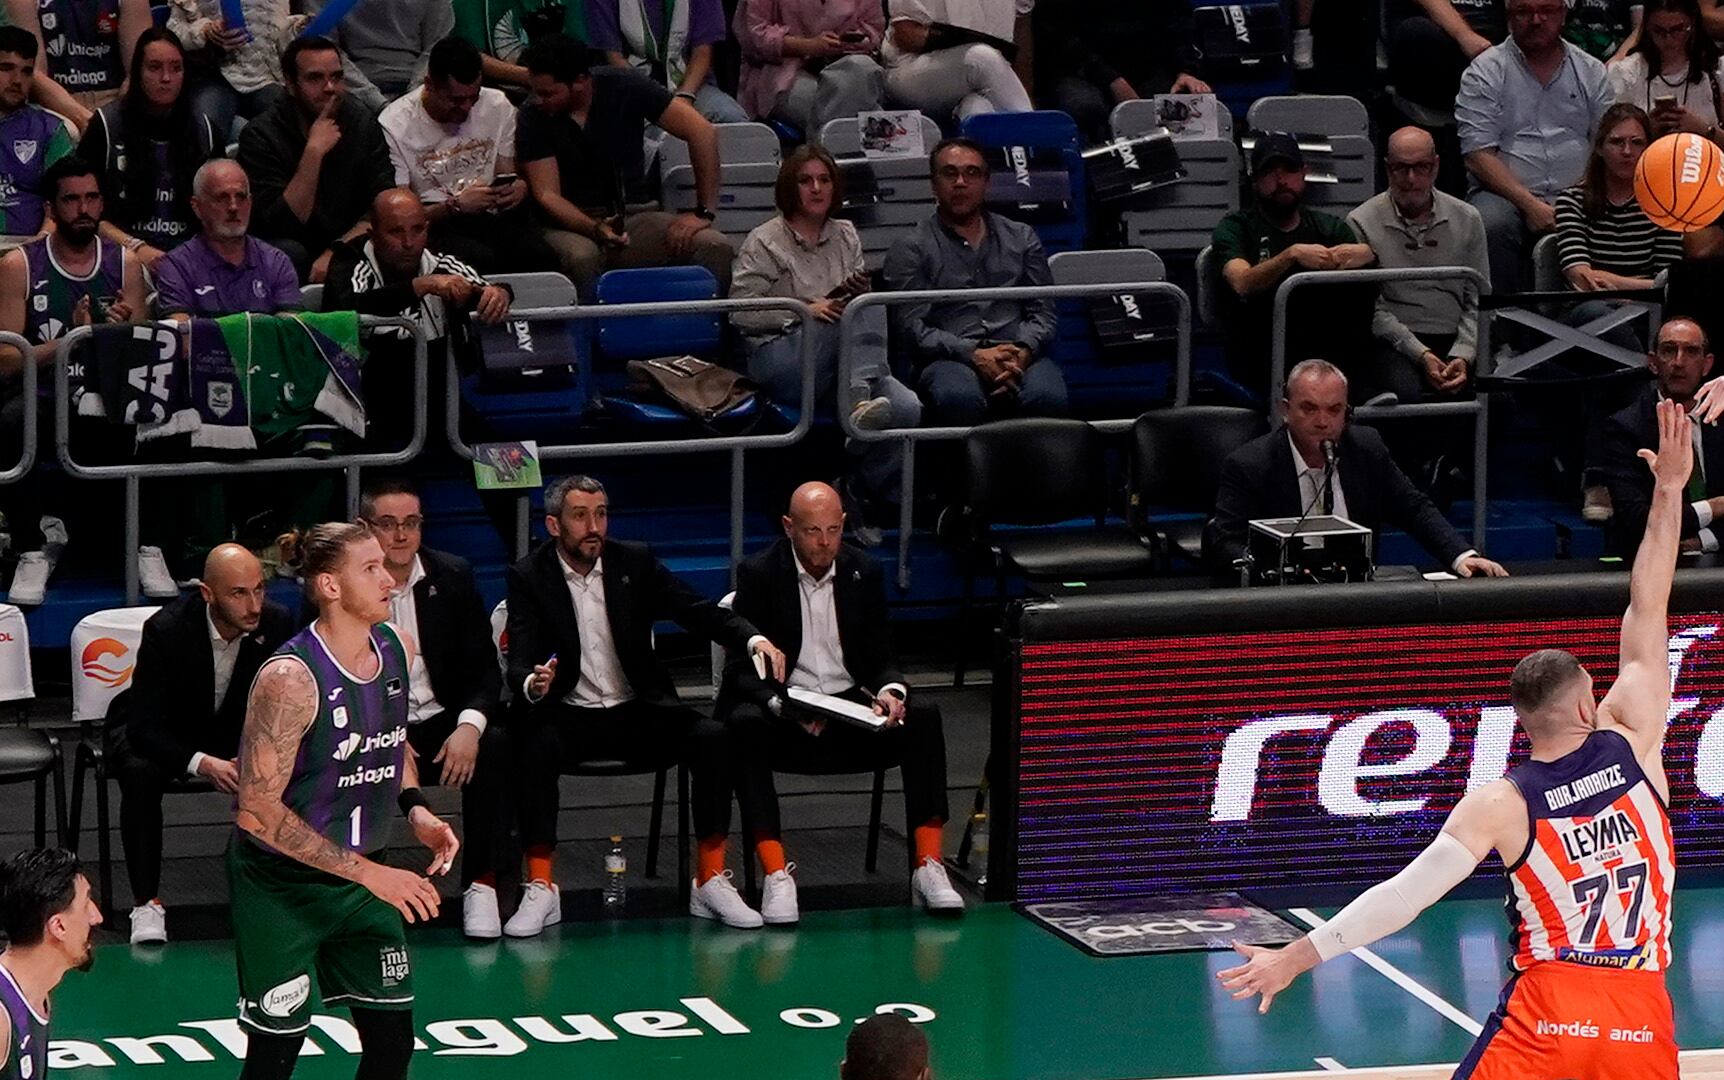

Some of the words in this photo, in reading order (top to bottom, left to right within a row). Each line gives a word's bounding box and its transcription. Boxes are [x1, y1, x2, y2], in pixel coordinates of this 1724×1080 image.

[1544, 764, 1627, 811] BURJANADZE
[349, 805, 362, 846] 1
[1562, 811, 1638, 861] LEYMA
[1594, 849, 1622, 863] NATURA
[1571, 862, 1647, 944] 77
[1086, 917, 1236, 939] acb
[1537, 1019, 1600, 1038] Nordés
[1610, 1025, 1653, 1043] ancín
